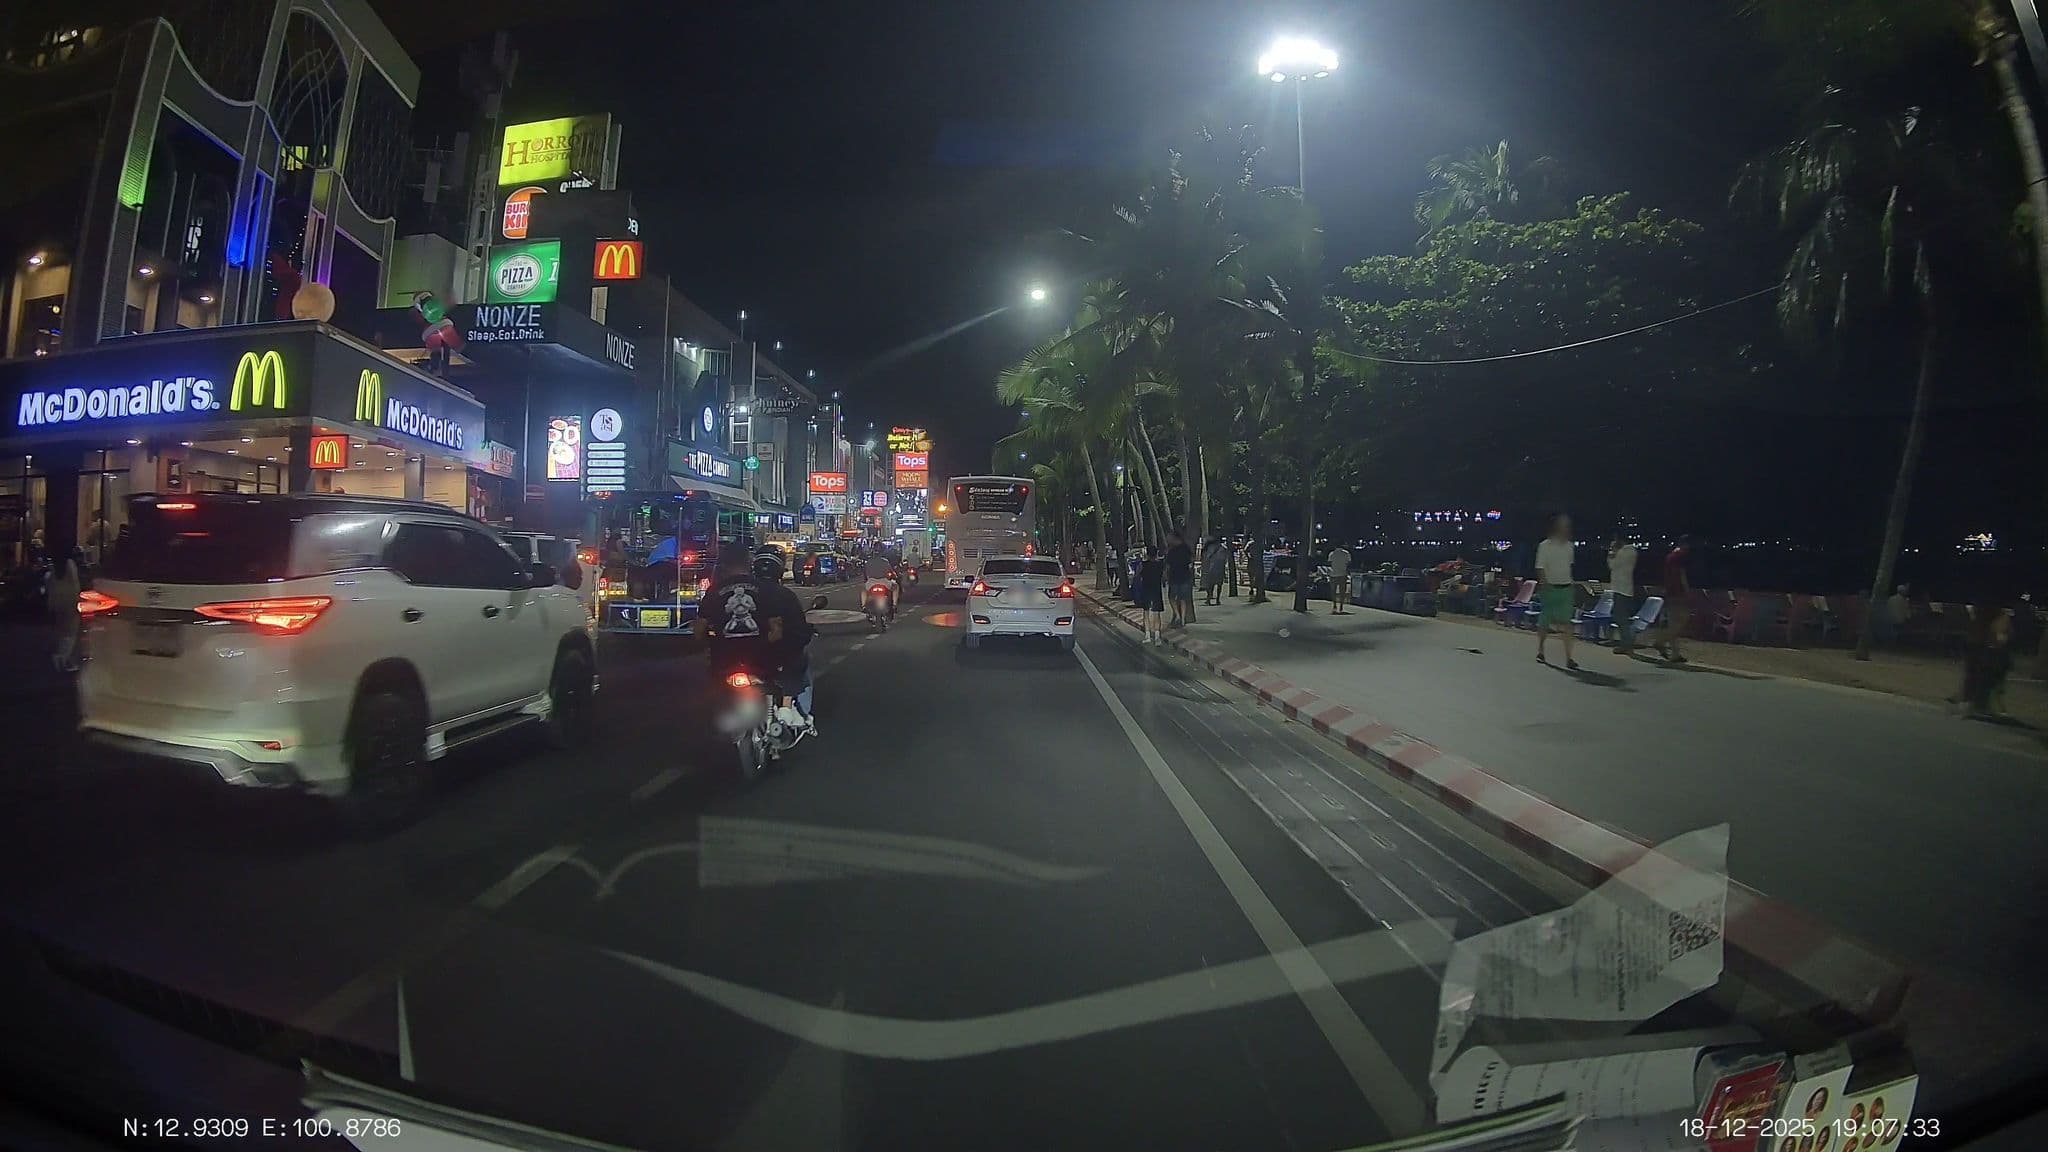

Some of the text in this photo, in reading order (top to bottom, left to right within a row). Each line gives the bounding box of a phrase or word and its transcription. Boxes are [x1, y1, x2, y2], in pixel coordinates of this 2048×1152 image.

[501, 266, 534, 284] PIZZA
[475, 305, 541, 328] NONZE
[606, 333, 635, 370] NONZE
[697, 450, 713, 478] PIZZA
[897, 455, 926, 468] Tops
[812, 474, 845, 489] Tops
